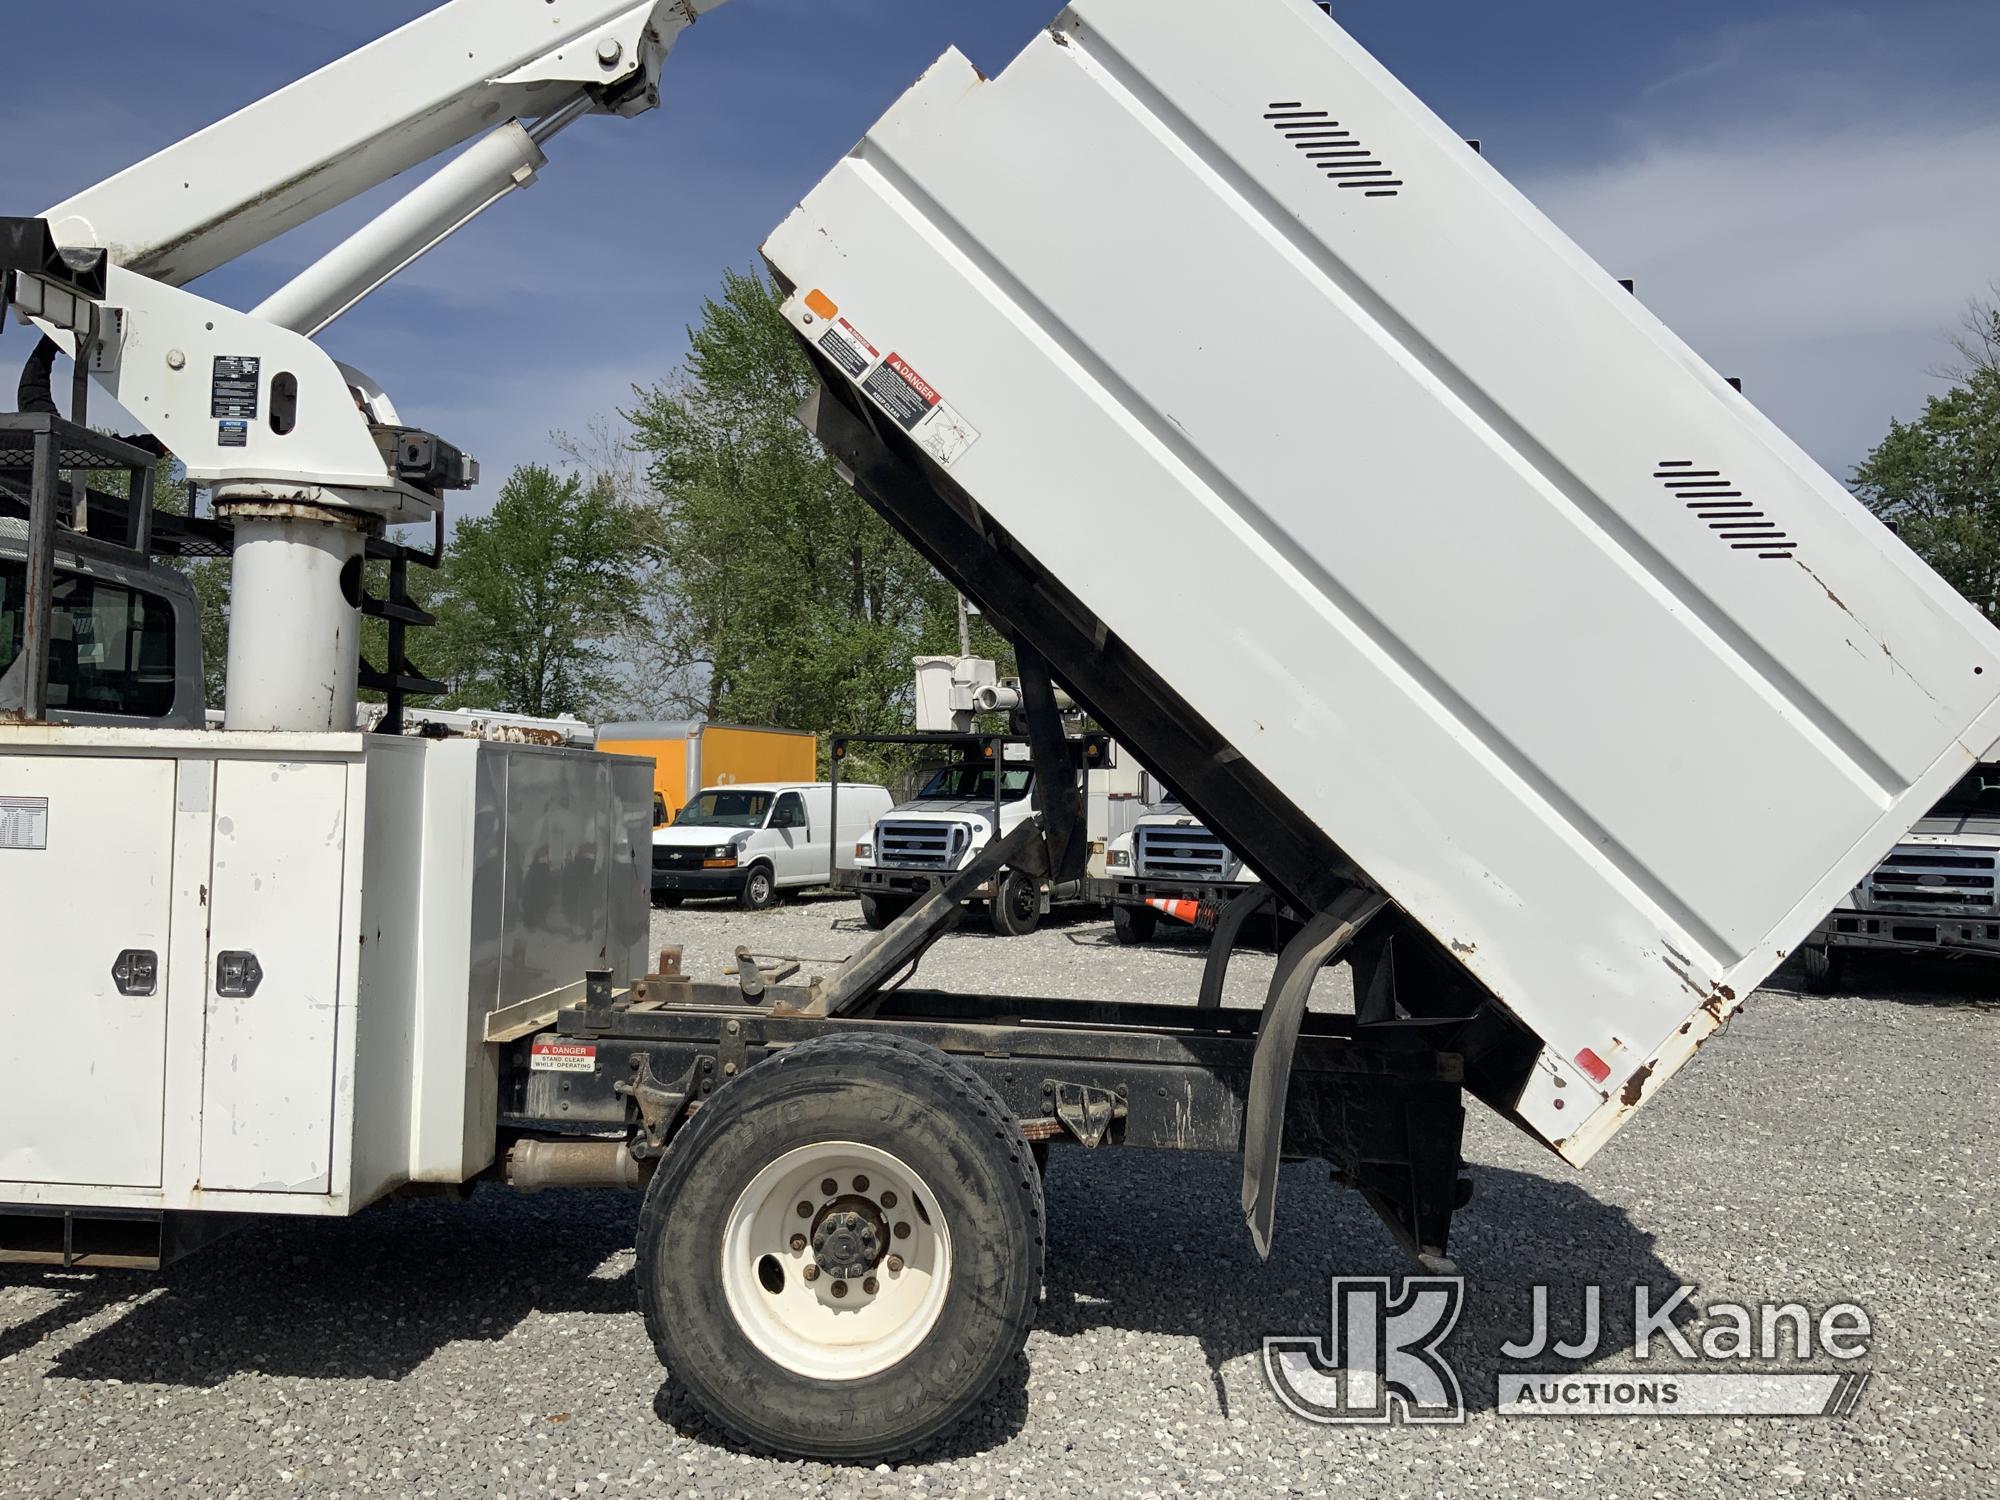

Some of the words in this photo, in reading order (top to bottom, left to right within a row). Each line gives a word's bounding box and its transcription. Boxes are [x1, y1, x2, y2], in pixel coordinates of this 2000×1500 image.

[899, 366, 934, 400] DANGER
[872, 391, 886, 404] KEEP
[883, 402, 900, 418] CLEAR
[552, 1046, 586, 1055] DANGER
